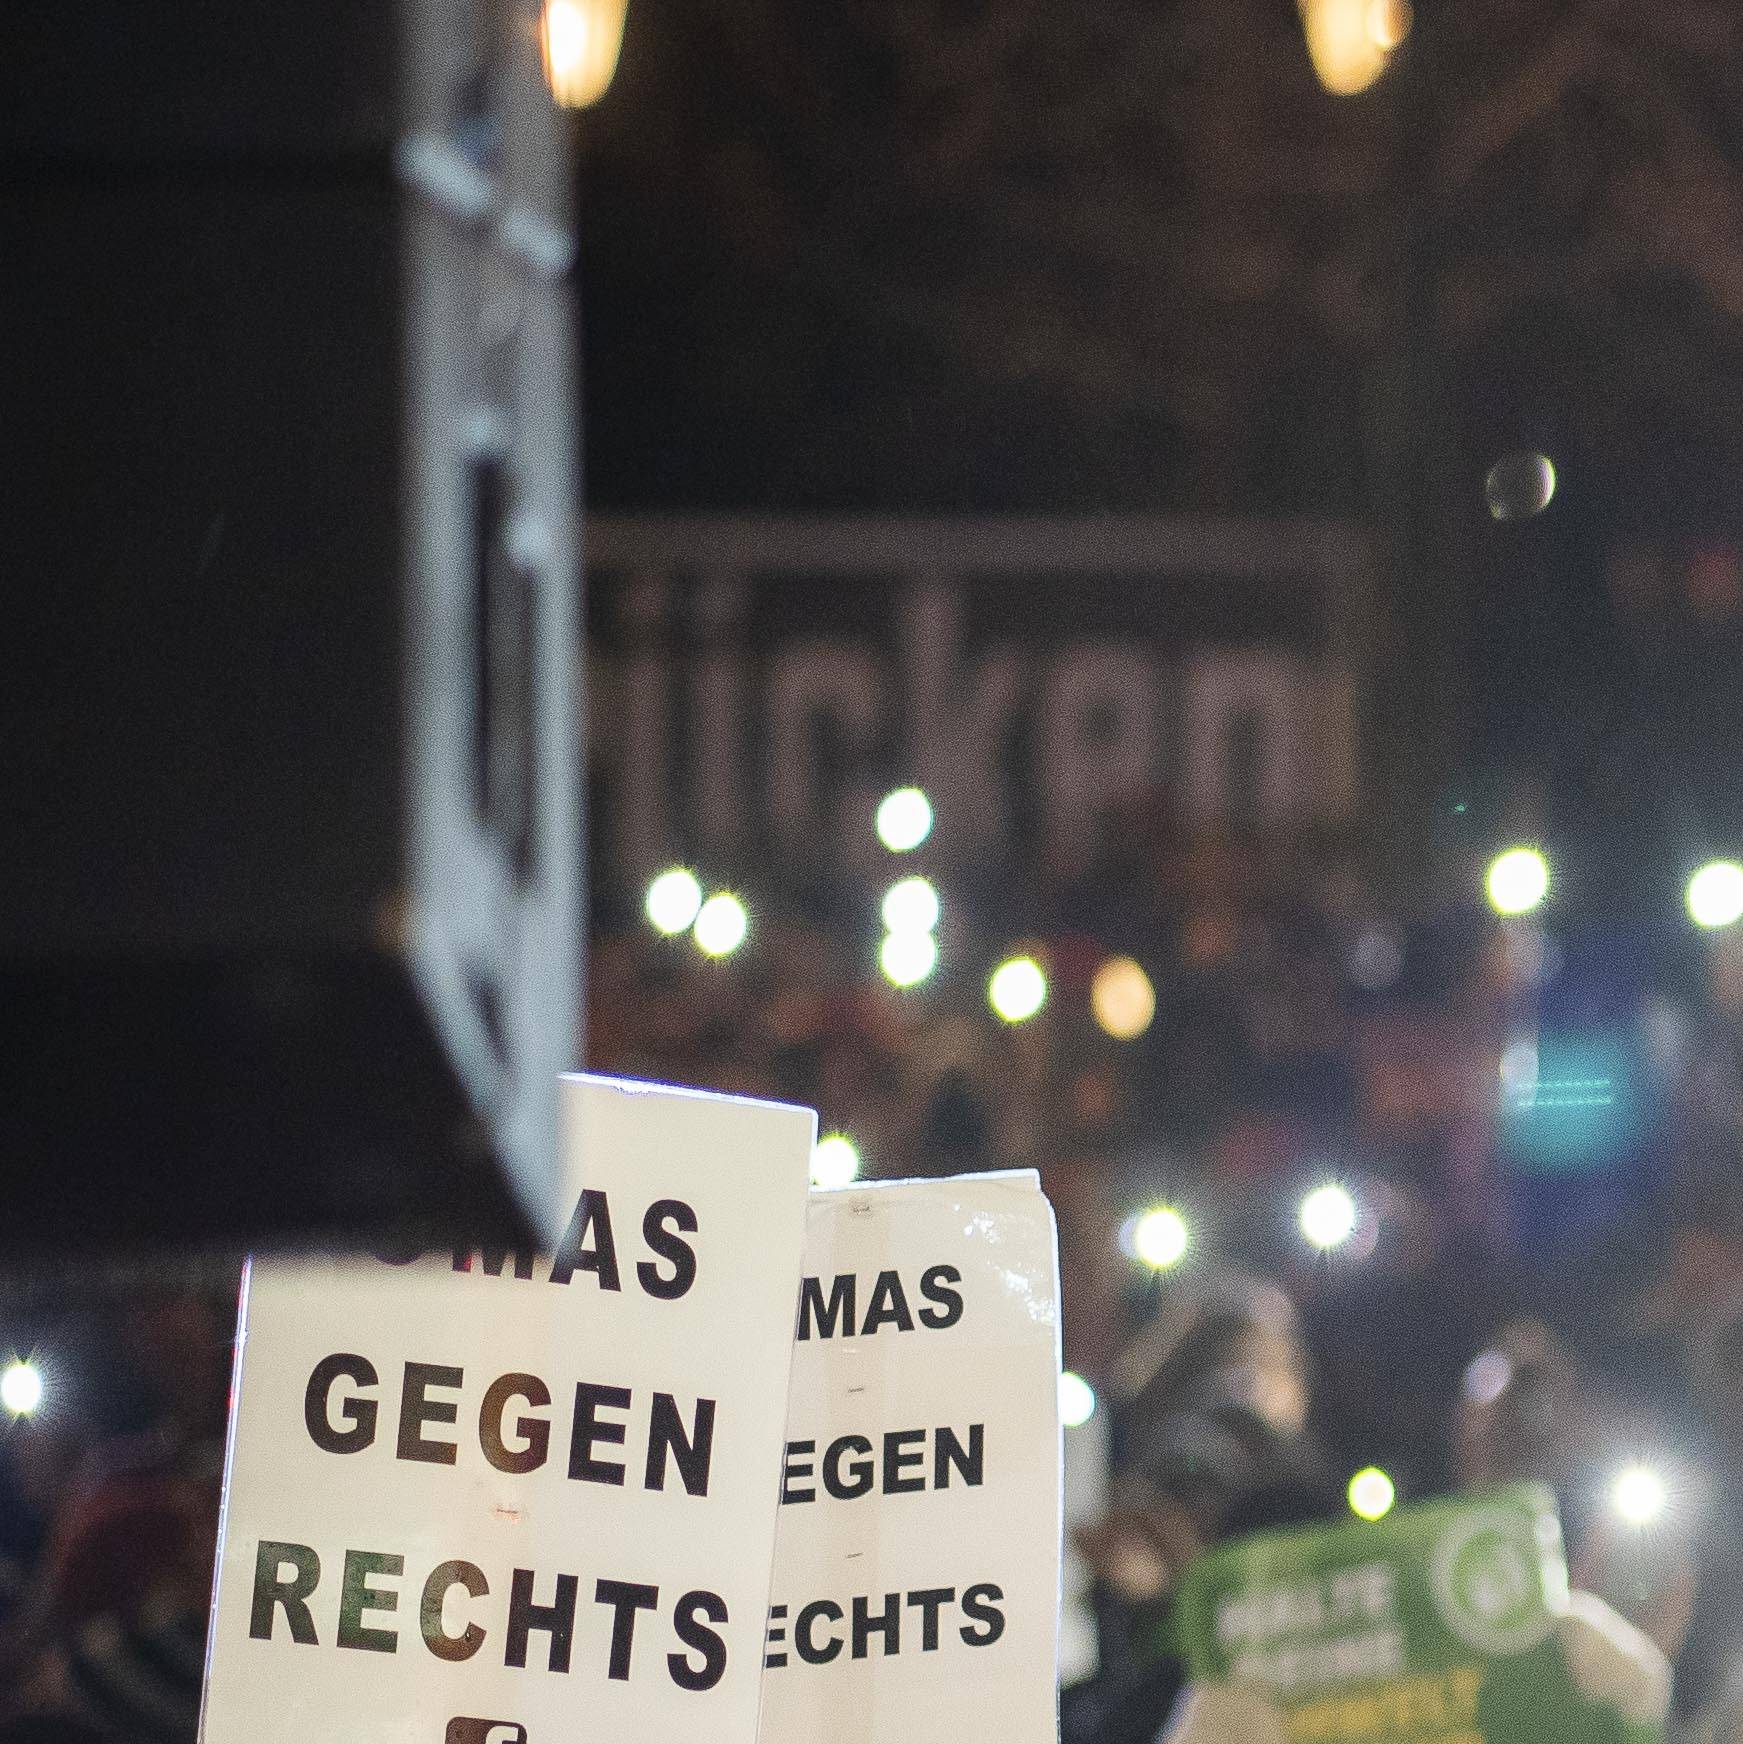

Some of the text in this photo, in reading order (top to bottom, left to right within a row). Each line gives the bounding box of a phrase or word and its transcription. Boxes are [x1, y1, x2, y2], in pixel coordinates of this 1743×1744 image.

[797, 1264, 964, 1342] MAS
[303, 1351, 717, 1498] GEGEN
[780, 1423, 985, 1506] EGEN
[248, 1539, 730, 1692] RECHTS
[765, 1582, 1006, 1669] ECHTS
